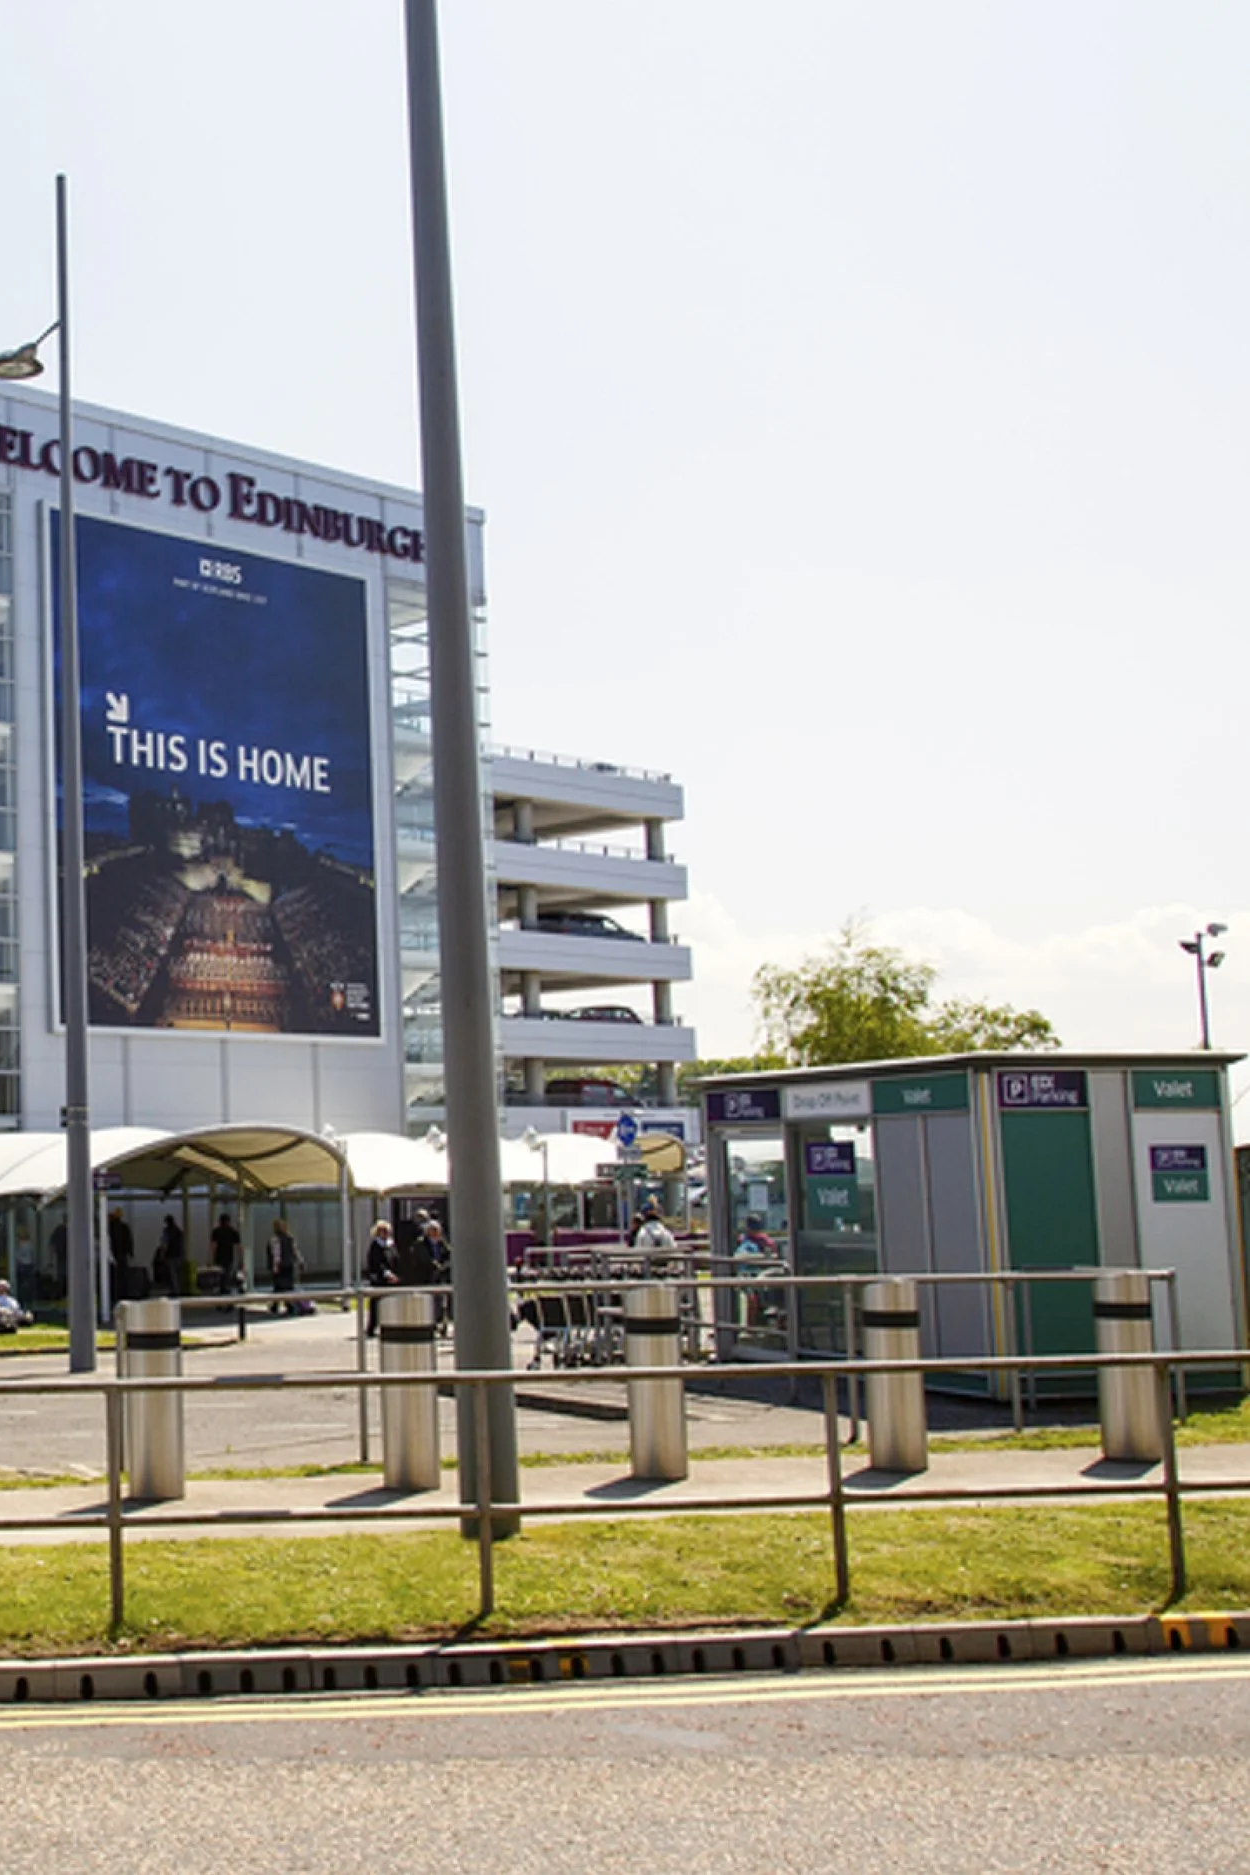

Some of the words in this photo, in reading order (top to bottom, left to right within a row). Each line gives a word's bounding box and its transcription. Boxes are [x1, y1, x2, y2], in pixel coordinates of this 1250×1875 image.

[106, 725, 188, 772] THIS
[199, 739, 229, 778] IS
[238, 745, 332, 794] HOME
[902, 1089, 932, 1105] Valet
[1152, 1080, 1193, 1098] Valet
[1163, 1178, 1199, 1195] Valet
[816, 1187, 850, 1207] Valet
